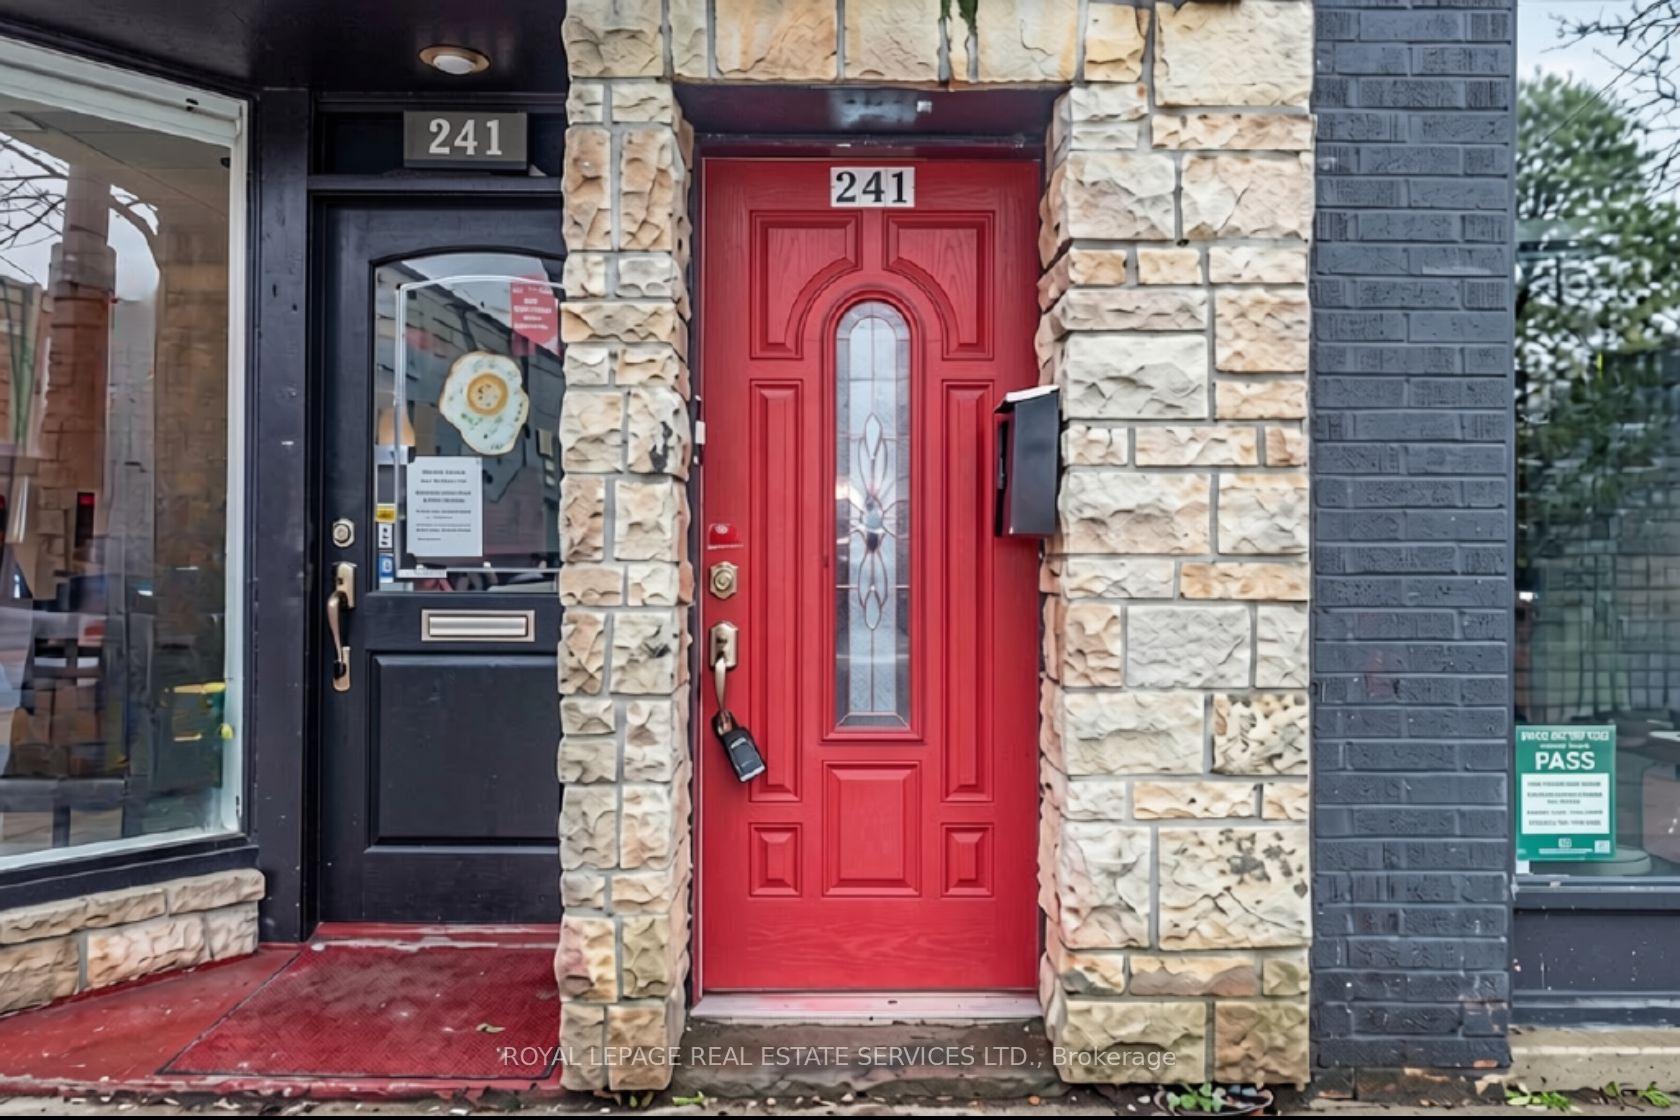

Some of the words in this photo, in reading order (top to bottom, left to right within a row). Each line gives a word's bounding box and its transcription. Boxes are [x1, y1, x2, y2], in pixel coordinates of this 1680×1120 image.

[428, 118, 502, 155] 241
[836, 170, 907, 203] 241
[1535, 751, 1596, 770] PASS
